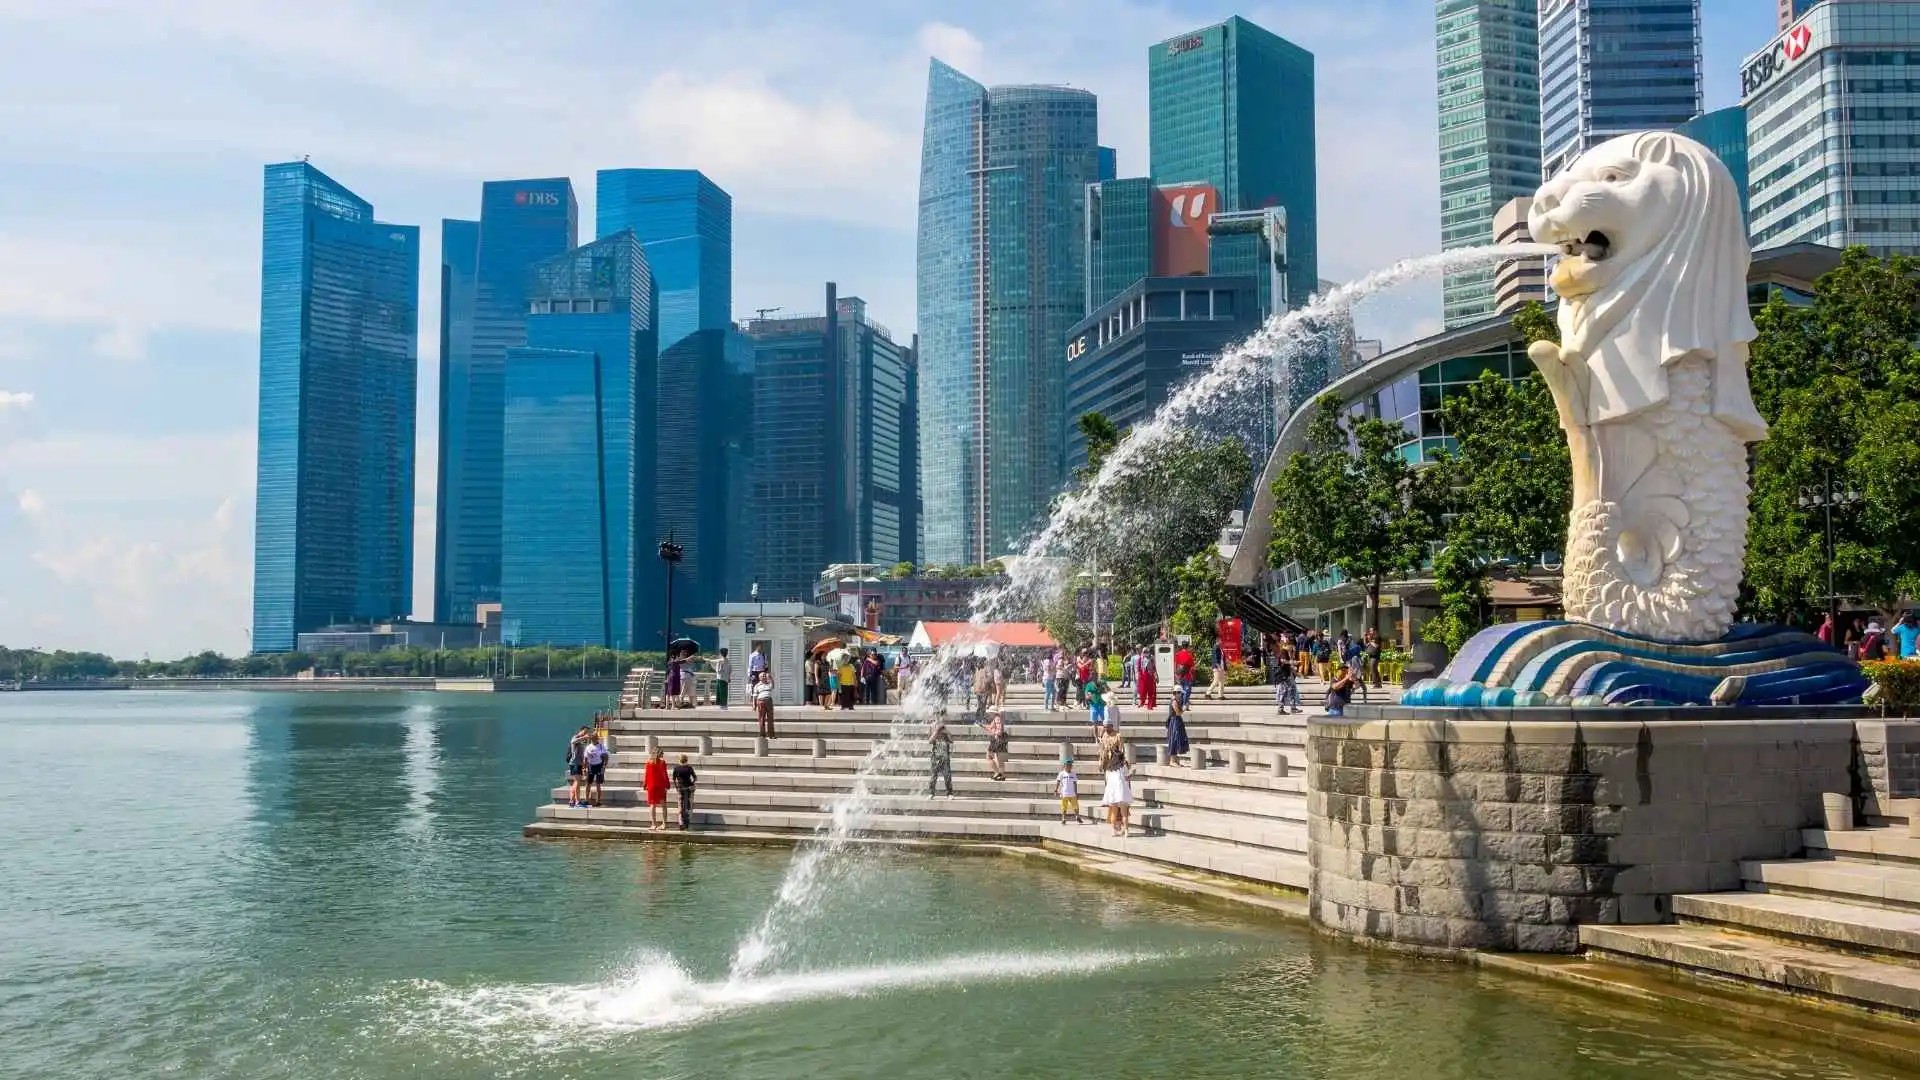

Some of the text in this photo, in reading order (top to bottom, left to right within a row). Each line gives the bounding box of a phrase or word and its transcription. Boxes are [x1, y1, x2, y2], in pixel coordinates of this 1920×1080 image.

[1740, 40, 1784, 98] HSBC
[529, 191, 560, 206] DBS
[1067, 336, 1086, 361] OUE
